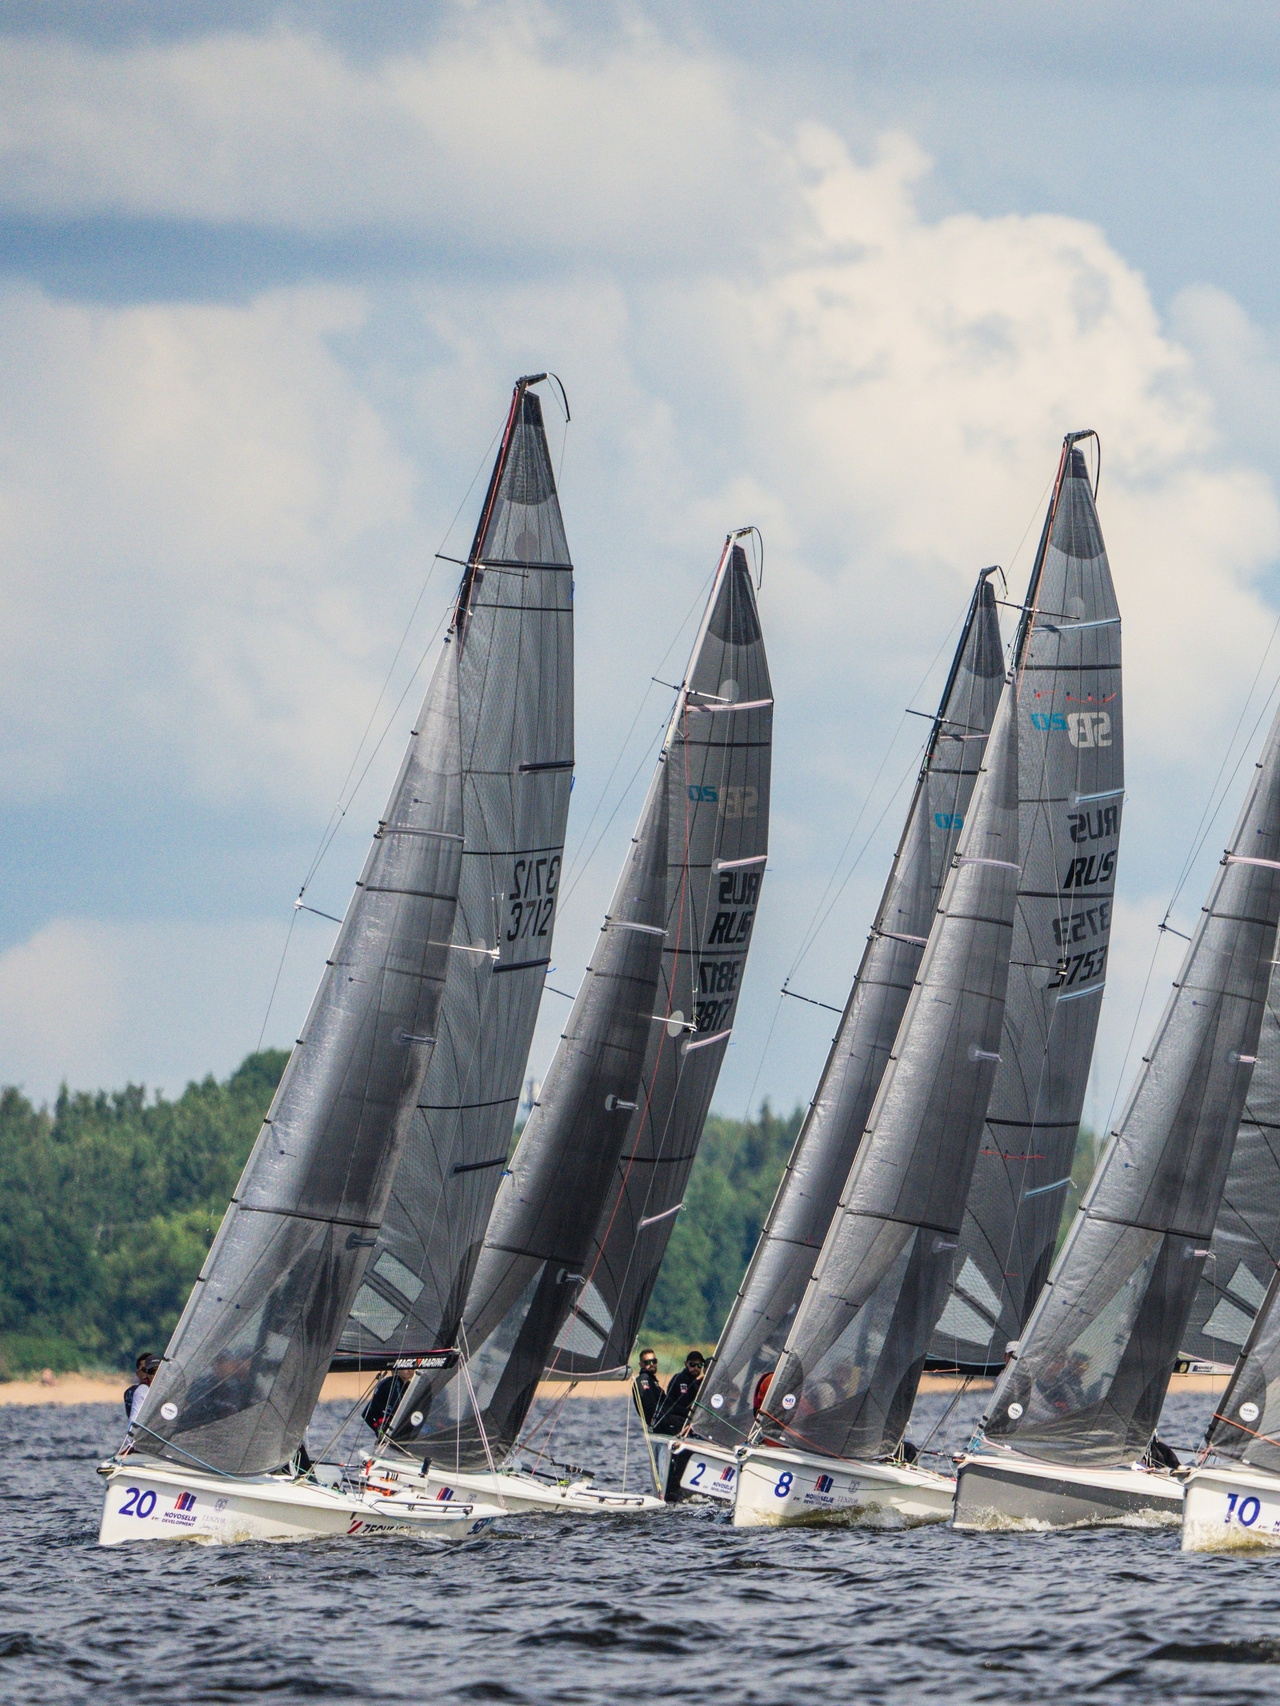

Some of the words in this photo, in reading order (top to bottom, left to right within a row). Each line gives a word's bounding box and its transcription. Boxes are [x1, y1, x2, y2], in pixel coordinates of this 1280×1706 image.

[1063, 850, 1117, 889] RUS
[507, 898, 554, 942] 3712
[708, 911, 754, 944] RUS
[1048, 945, 1108, 989] 3753
[393, 1358, 417, 1369] MAGIC
[418, 1357, 447, 1368] MARINE
[690, 1462, 706, 1487] 2
[774, 1471, 794, 1498] 8
[118, 1487, 157, 1519] 20
[164, 1511, 197, 1523] NOVOSELIE
[1224, 1493, 1261, 1527] 10
[161, 1519, 195, 1528] DEVELOPMENT
